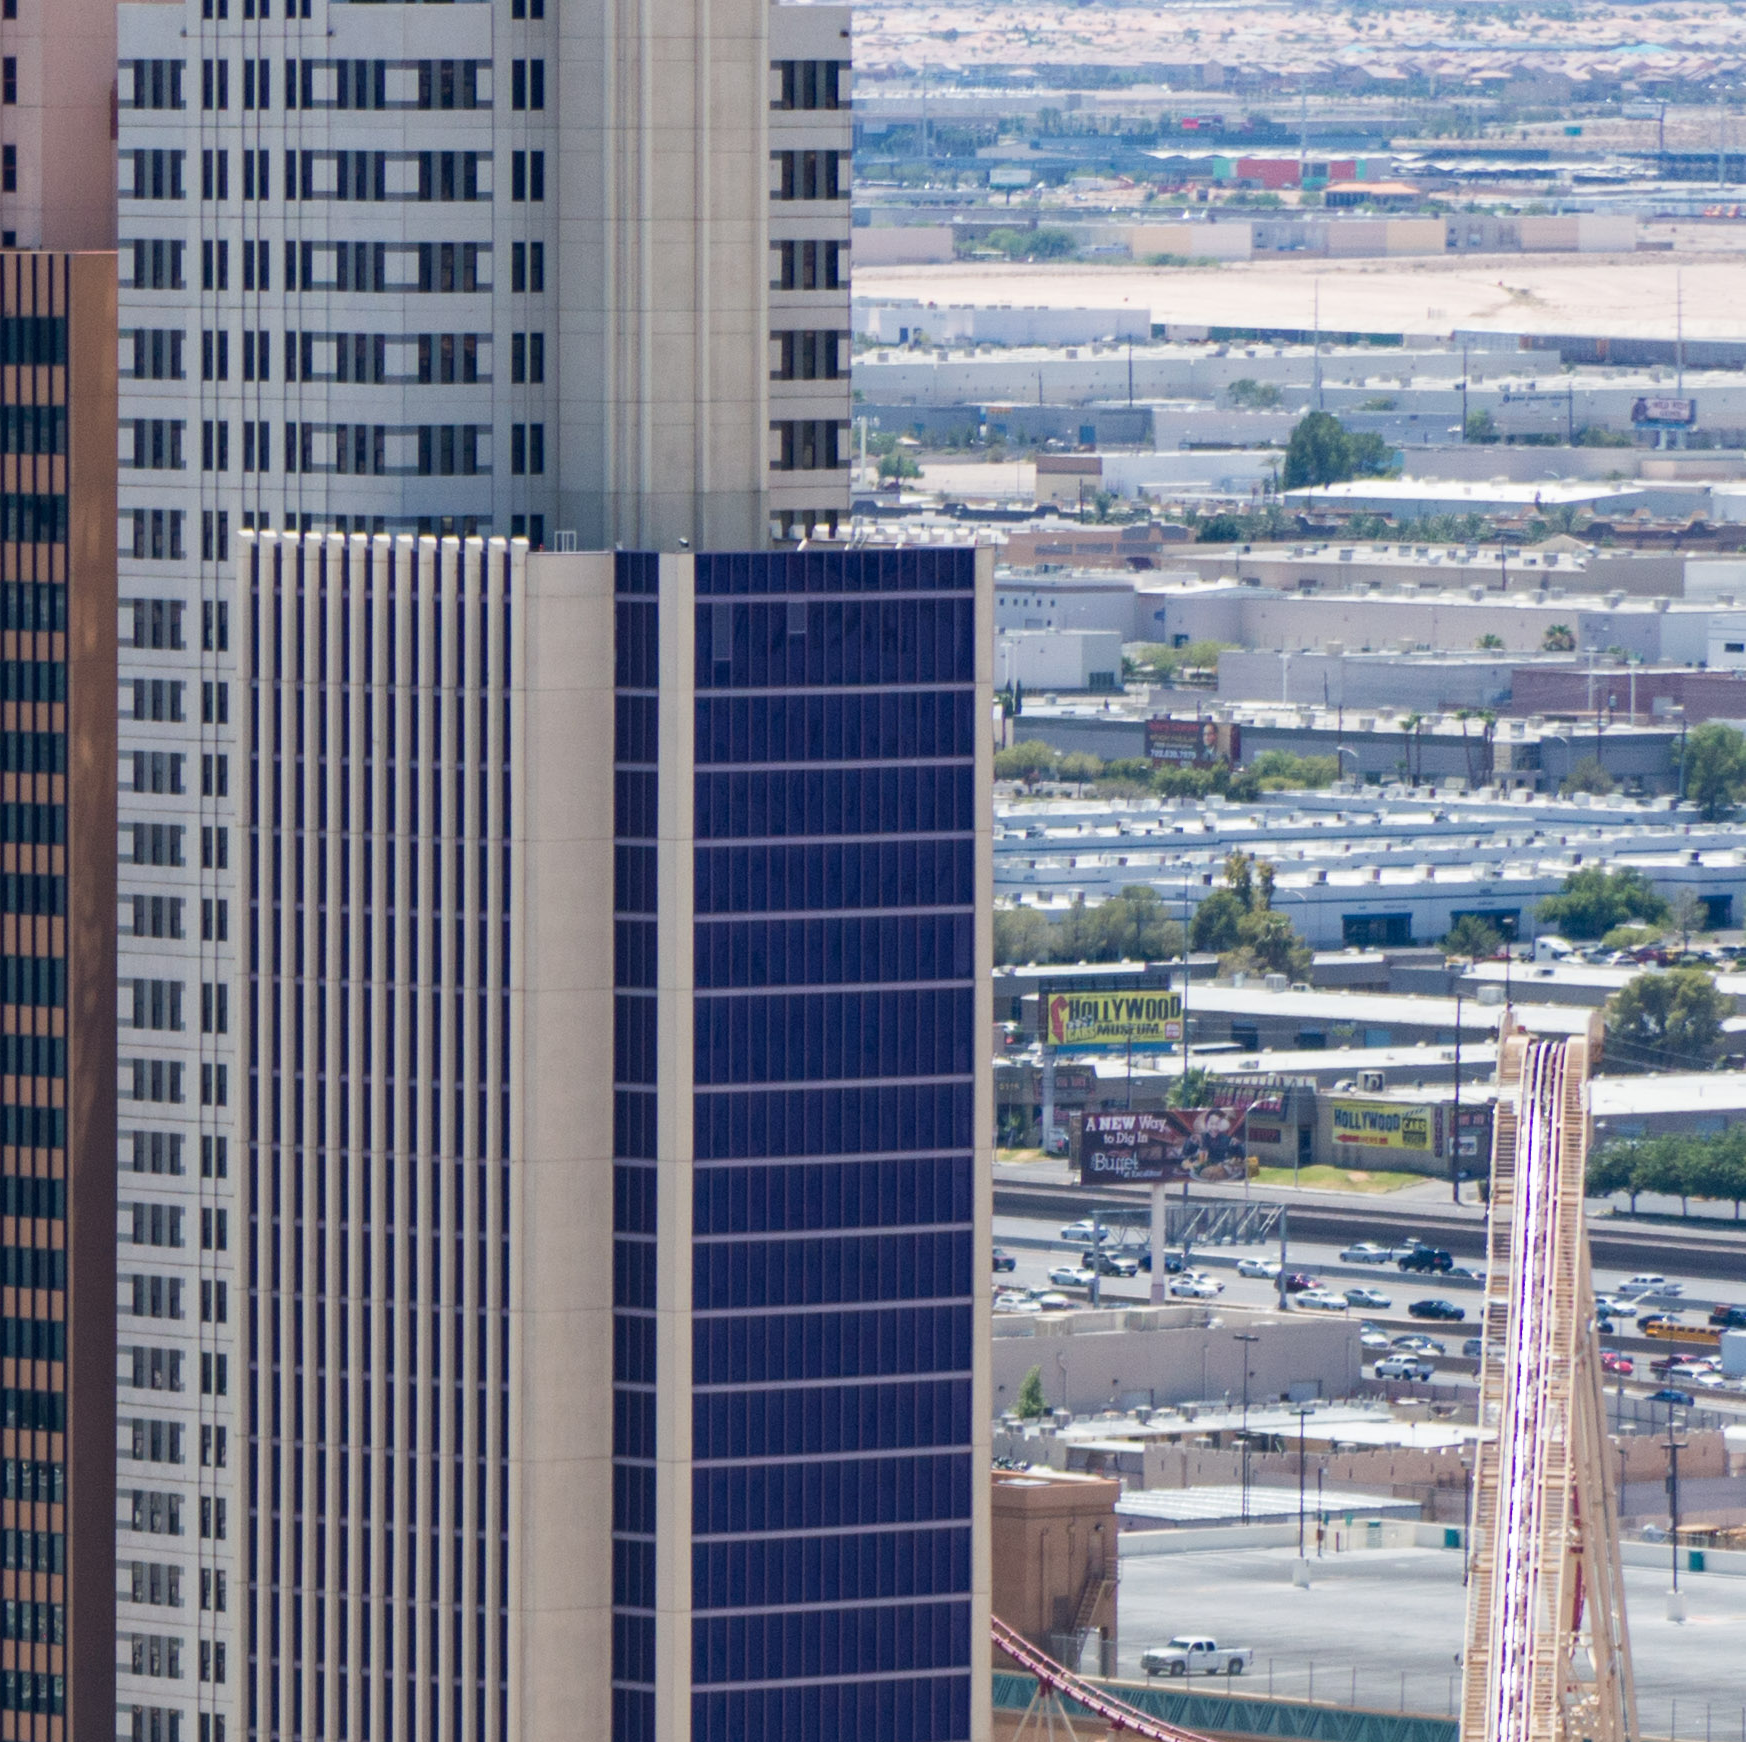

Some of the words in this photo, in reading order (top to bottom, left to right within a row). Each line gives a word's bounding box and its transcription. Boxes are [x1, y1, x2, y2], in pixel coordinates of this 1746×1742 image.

[1069, 995, 1182, 1022] HOLLYWOOD
[1086, 1117, 1096, 1132] A
[1099, 1116, 1136, 1131] NEW
[1334, 1108, 1400, 1131] HOLLYWOOD
[1104, 1133, 1114, 1144] to
[1116, 1132, 1134, 1146] Dig
[1094, 1152, 1139, 1174] Buffet
